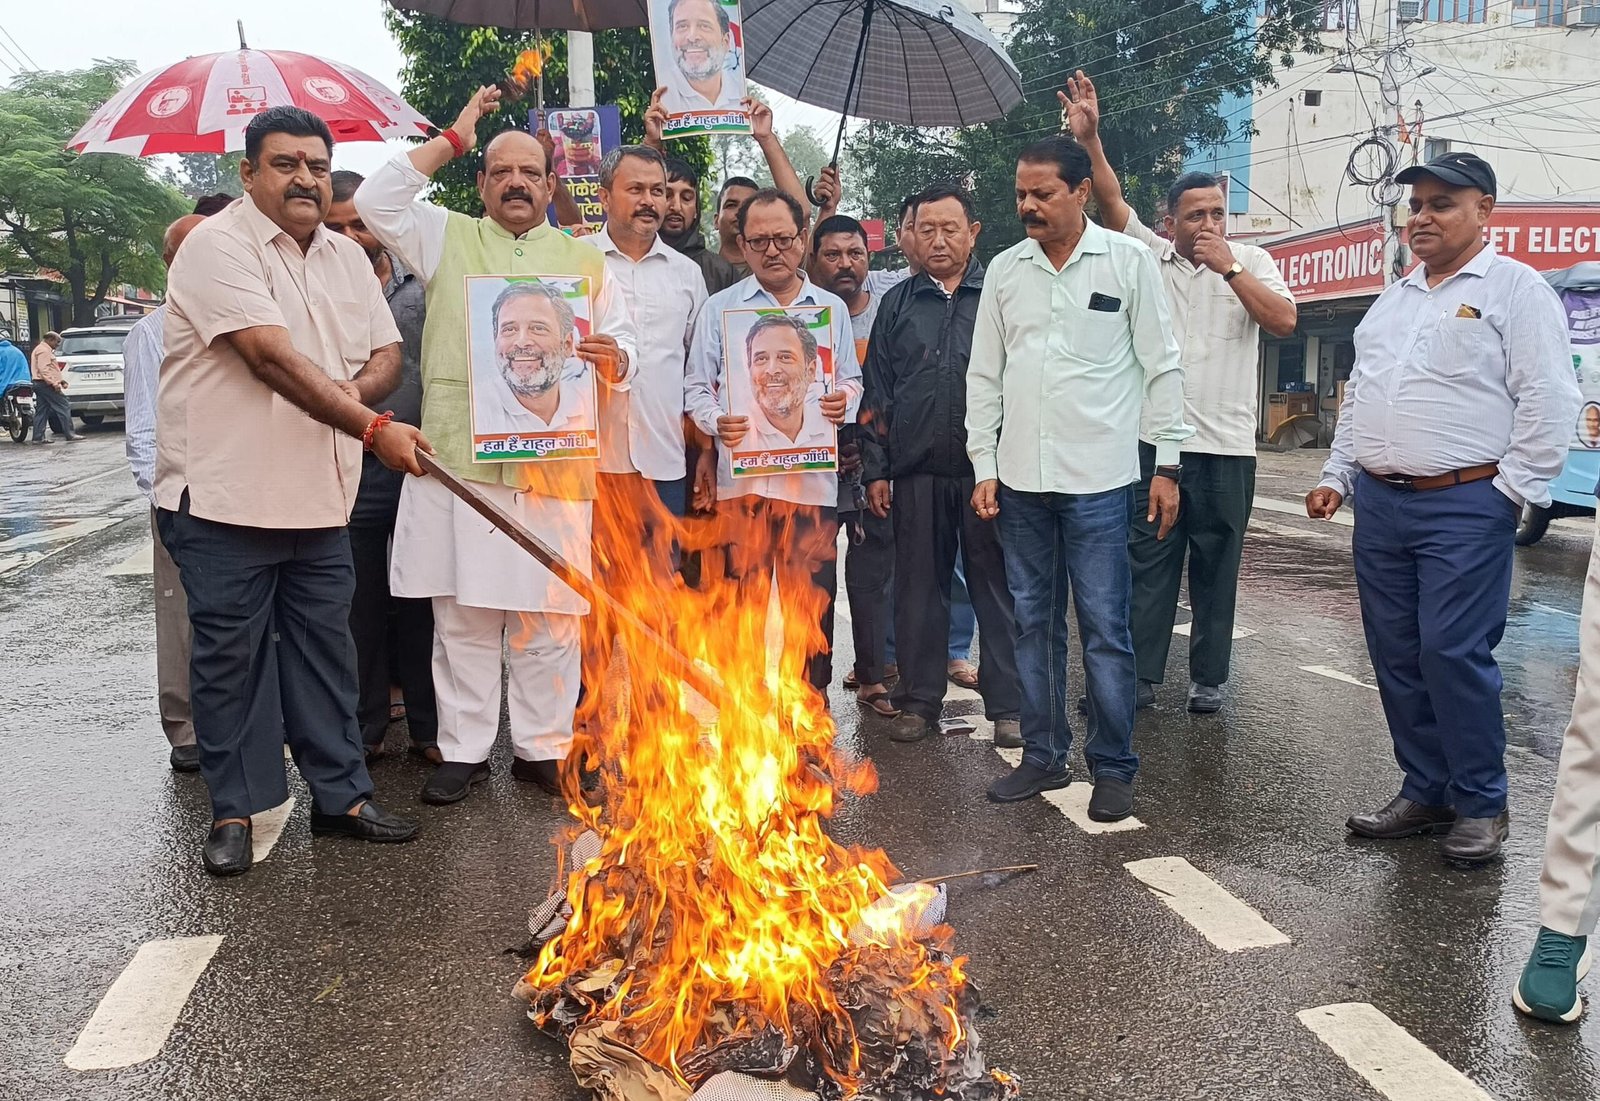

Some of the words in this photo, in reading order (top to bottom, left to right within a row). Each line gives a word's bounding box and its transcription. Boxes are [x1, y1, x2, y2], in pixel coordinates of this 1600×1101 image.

[667, 118, 681, 129] हम
[683, 114, 692, 127] हैं
[694, 115, 719, 129] राहुल
[483, 440, 504, 452] हम
[508, 436, 519, 451] हैं
[522, 439, 555, 455] राहुल
[740, 457, 758, 467] हम
[760, 453, 769, 466] हैं
[773, 454, 799, 468] राहुल
